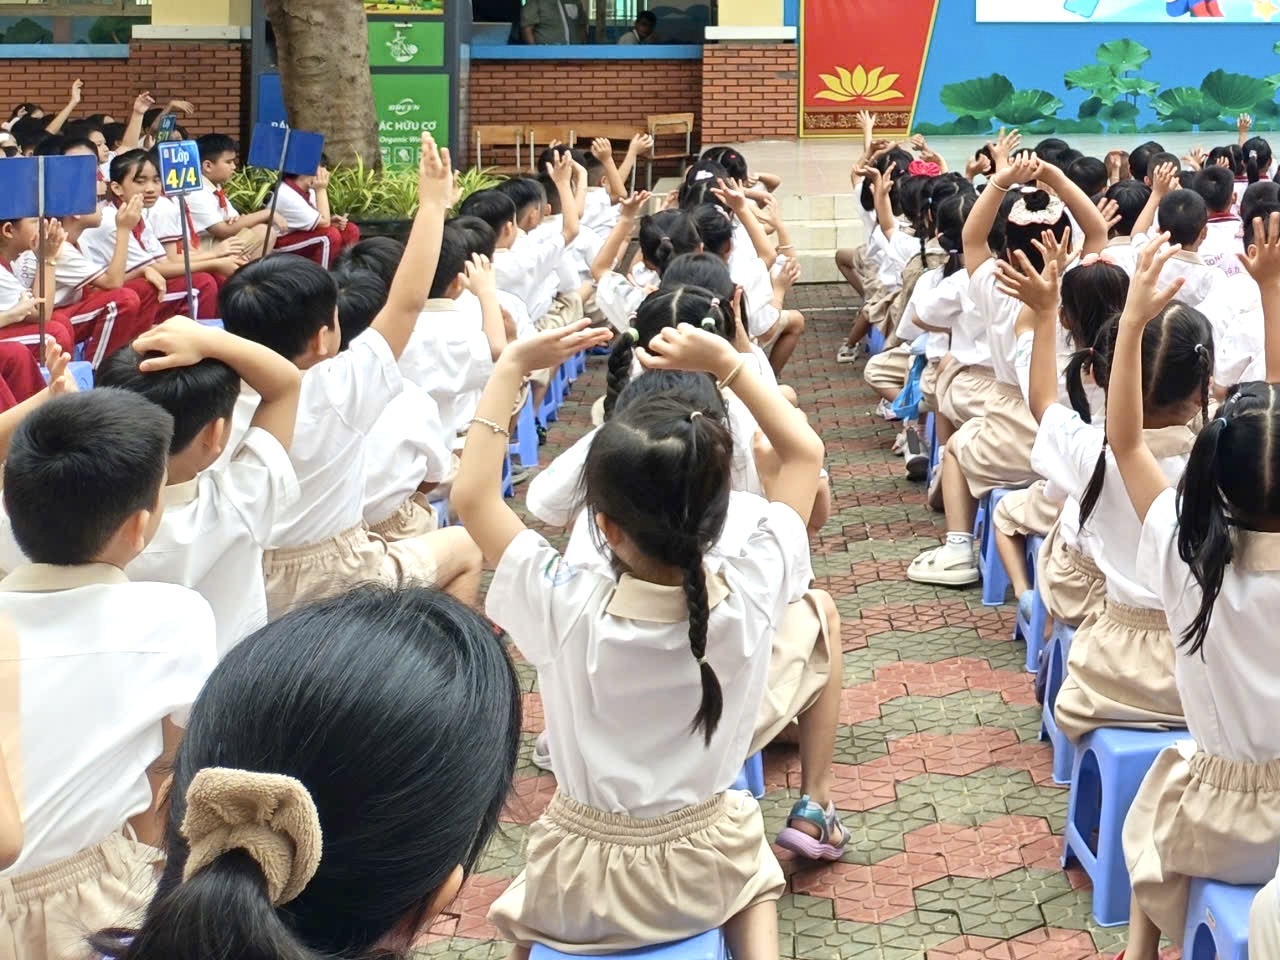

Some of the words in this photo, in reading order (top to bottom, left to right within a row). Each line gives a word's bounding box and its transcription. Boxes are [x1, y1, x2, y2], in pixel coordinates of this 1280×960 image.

[379, 119, 394, 130] ÁC
[171, 147, 190, 166] Lớp
[166, 166, 197, 189] 4/4
